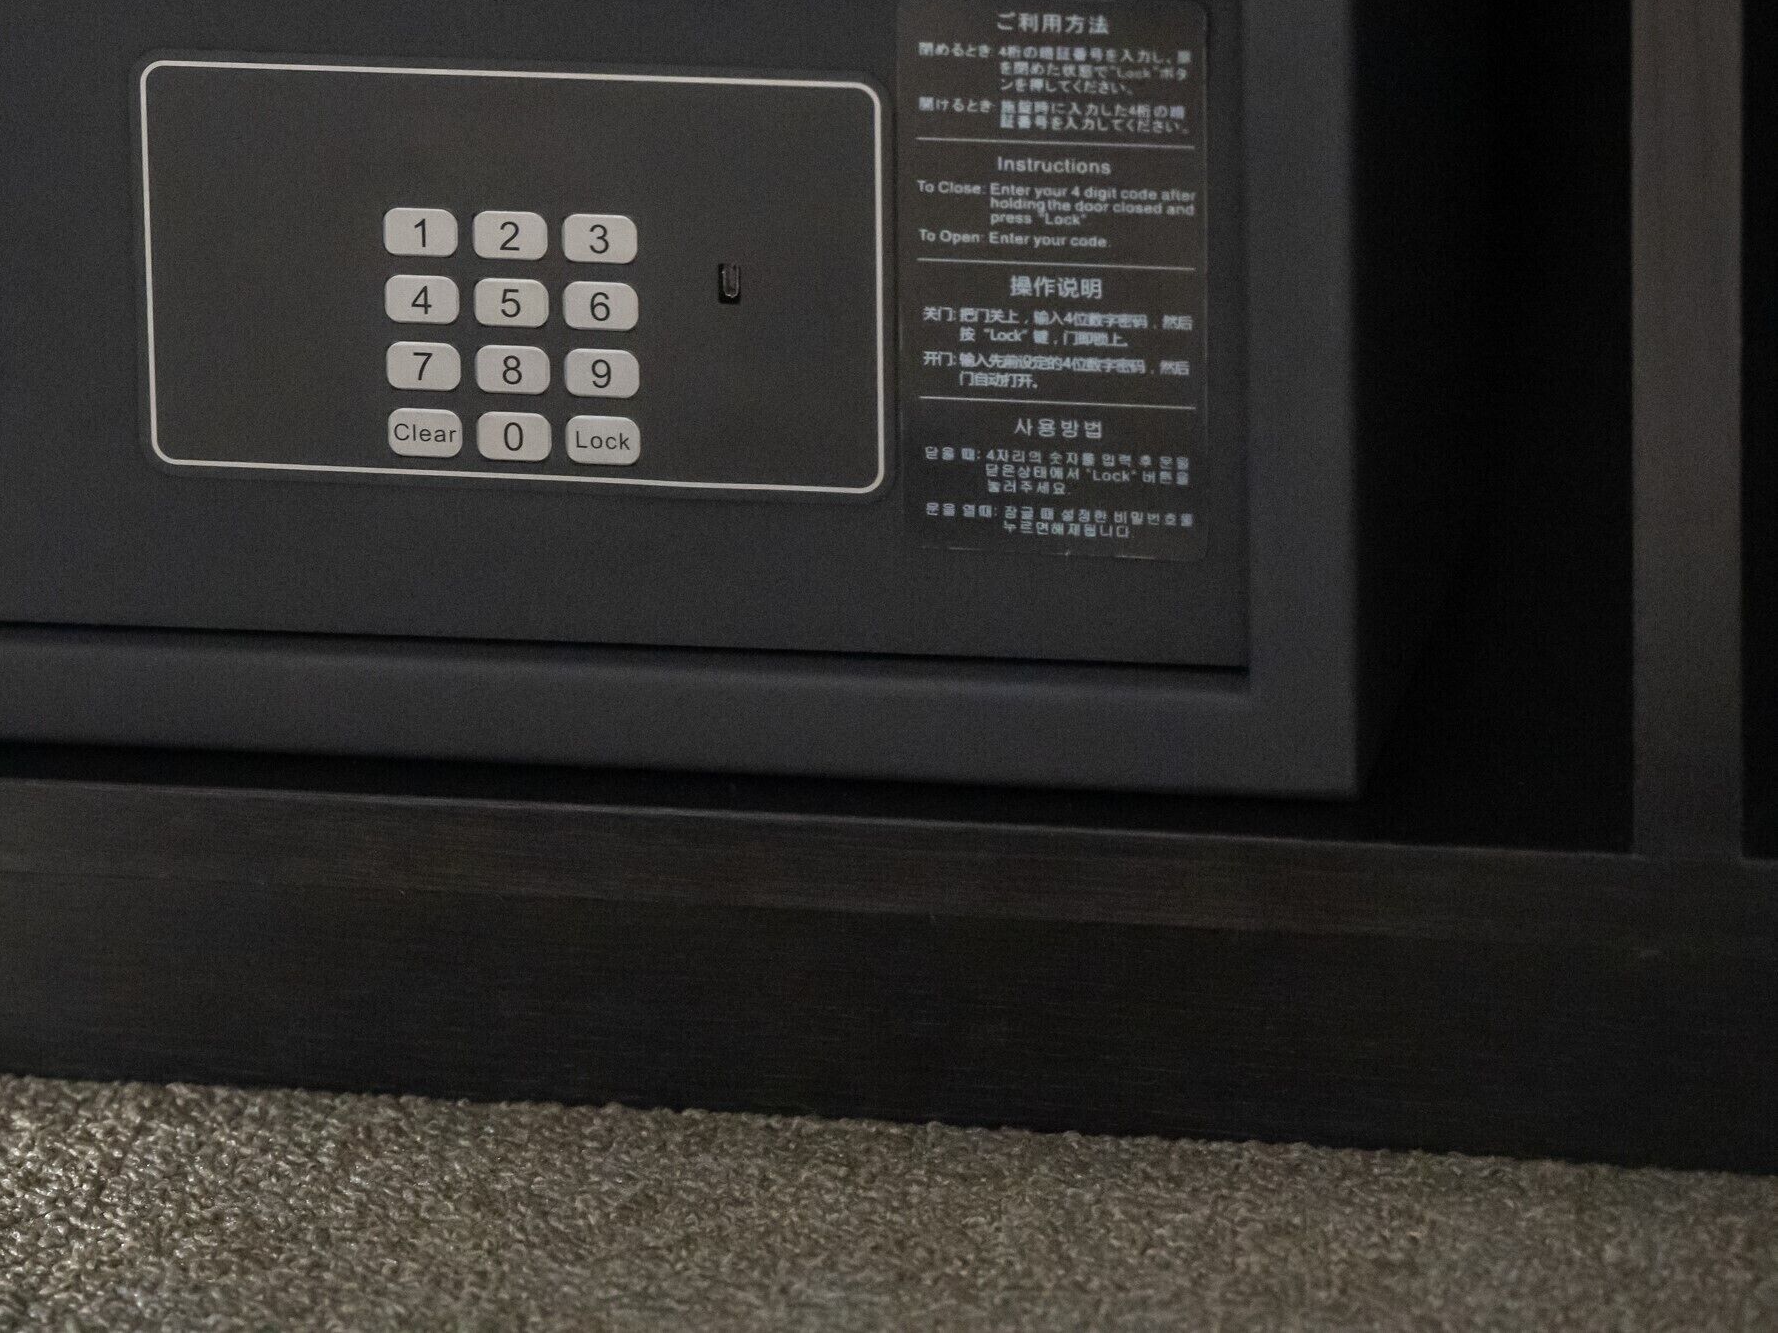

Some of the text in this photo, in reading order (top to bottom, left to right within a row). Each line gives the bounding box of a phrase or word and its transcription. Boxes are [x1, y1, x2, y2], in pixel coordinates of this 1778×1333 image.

[997, 12, 1109, 35] ご利用方法
[998, 157, 1111, 174] Instructions
[917, 180, 934, 193] To
[990, 183, 1031, 196] Enter
[1035, 187, 1066, 200] your
[1070, 186, 1080, 197] 4
[1084, 186, 1116, 202] digit
[1121, 187, 1157, 200] code
[1161, 188, 1196, 202] after
[990, 197, 1194, 216] holding the door closed and
[990, 213, 1032, 227] press
[414, 219, 609, 254] 1 2 3
[919, 229, 935, 242] To
[989, 231, 1029, 245] Enter
[1033, 234, 1066, 249] your
[1010, 275, 1102, 299] 操作说明
[411, 286, 610, 321] 4 5 6
[413, 352, 611, 388] 7 8 9
[393, 422, 631, 451] Clear 0 Lock
[1014, 418, 1102, 438] 사용방법
[1102, 454, 1132, 467] 입력
[1041, 507, 1055, 520] 때
[1062, 508, 1108, 523] 설정한
